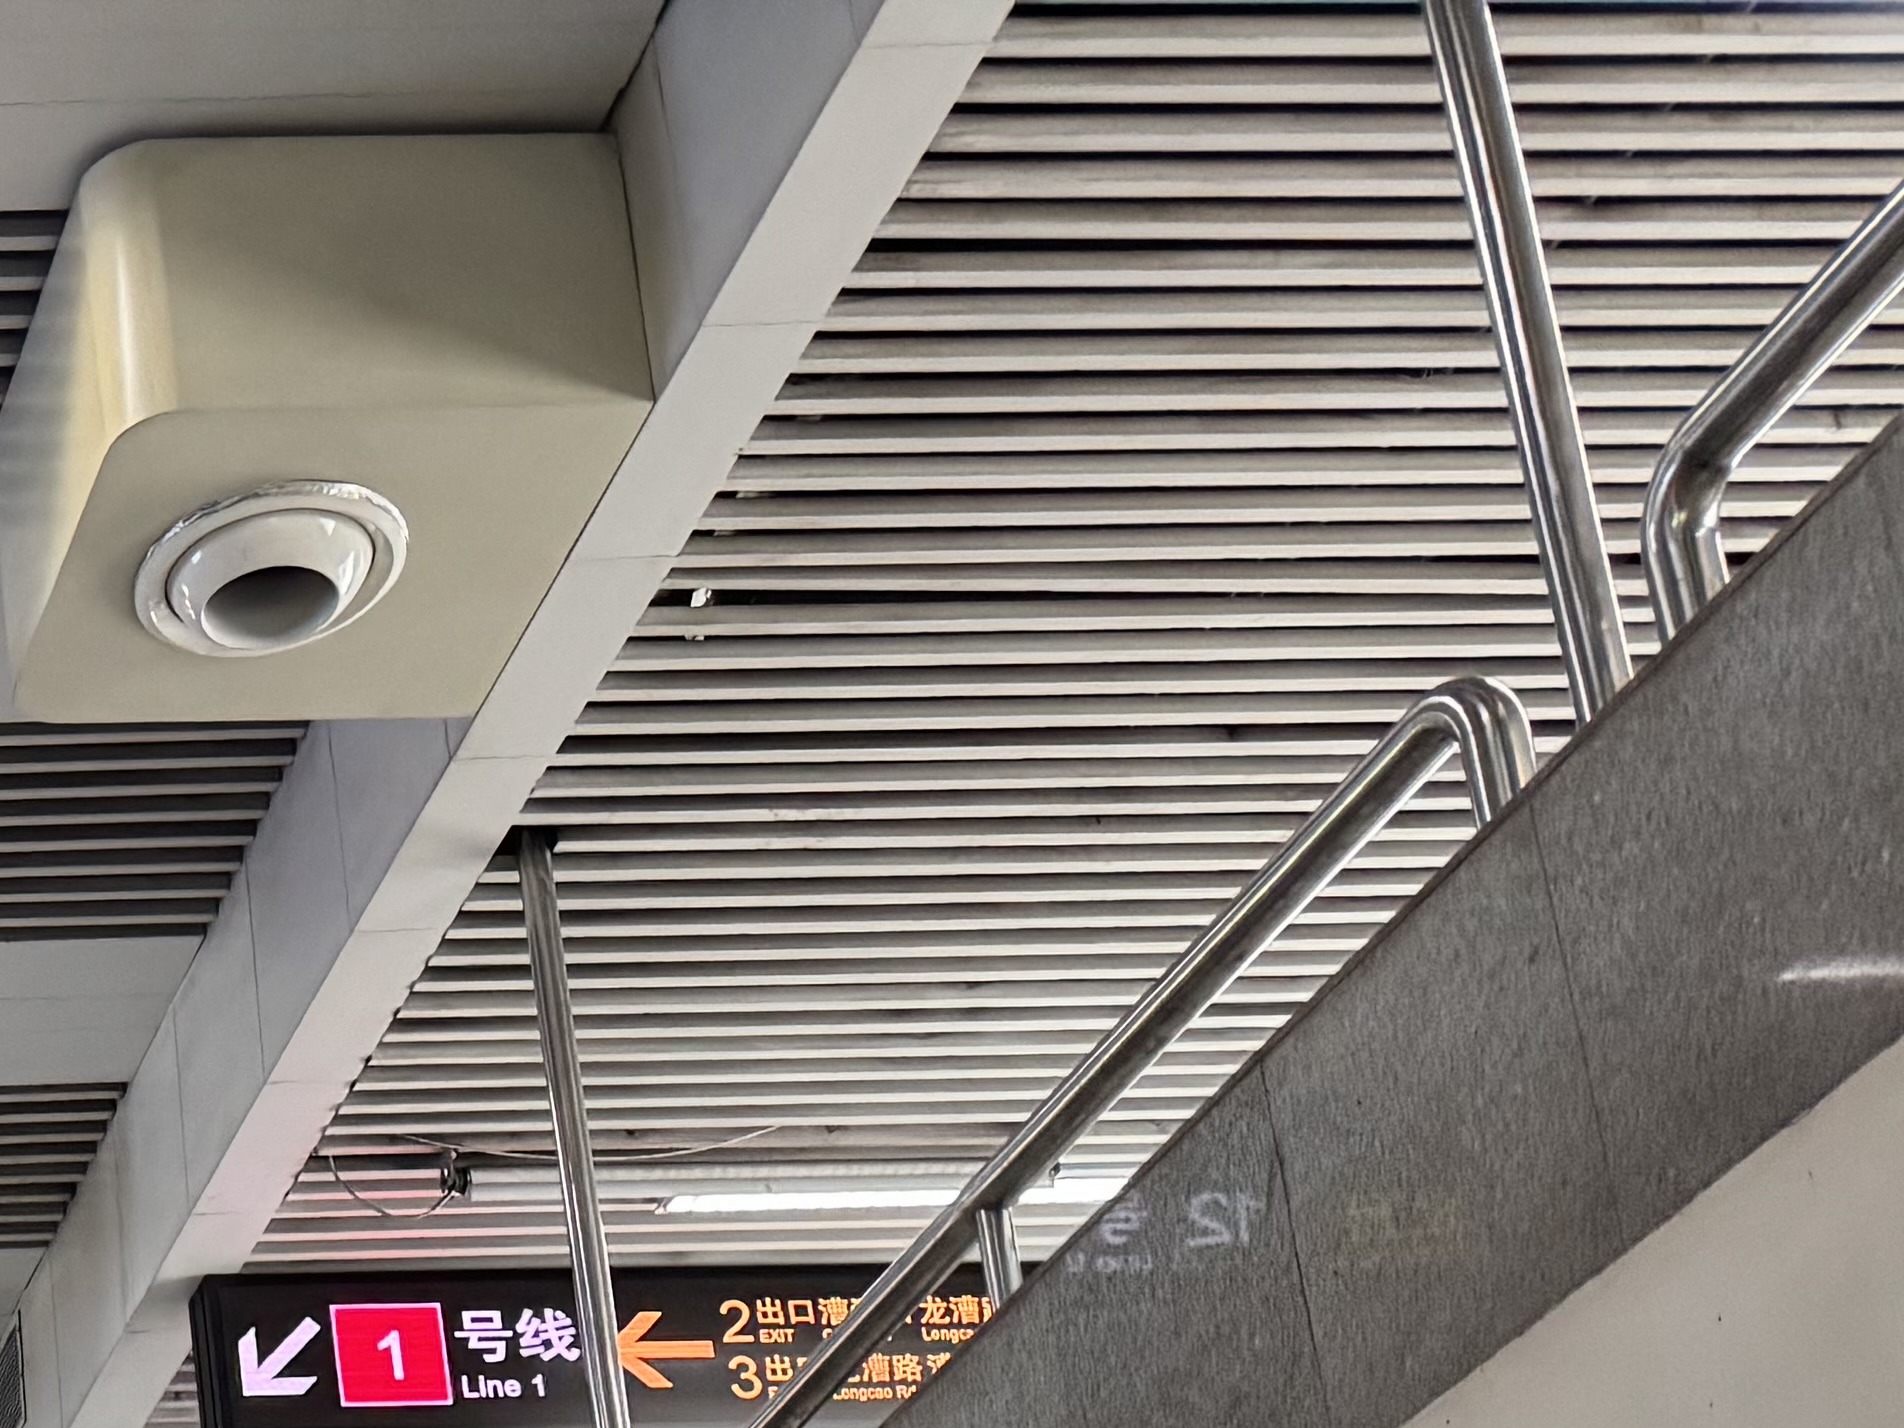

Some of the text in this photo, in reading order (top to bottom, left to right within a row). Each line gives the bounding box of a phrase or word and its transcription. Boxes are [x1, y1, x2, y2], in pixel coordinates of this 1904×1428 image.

[719, 1299, 755, 1343] 2
[756, 1297, 815, 1325] 出口
[759, 1328, 794, 1343] EXIT
[377, 1308, 581, 1381] 1 号线
[461, 1373, 546, 1399] Line 1
[728, 1355, 763, 1400] 3
[765, 1354, 808, 1382] 出
[848, 1353, 923, 1383] 漕路
